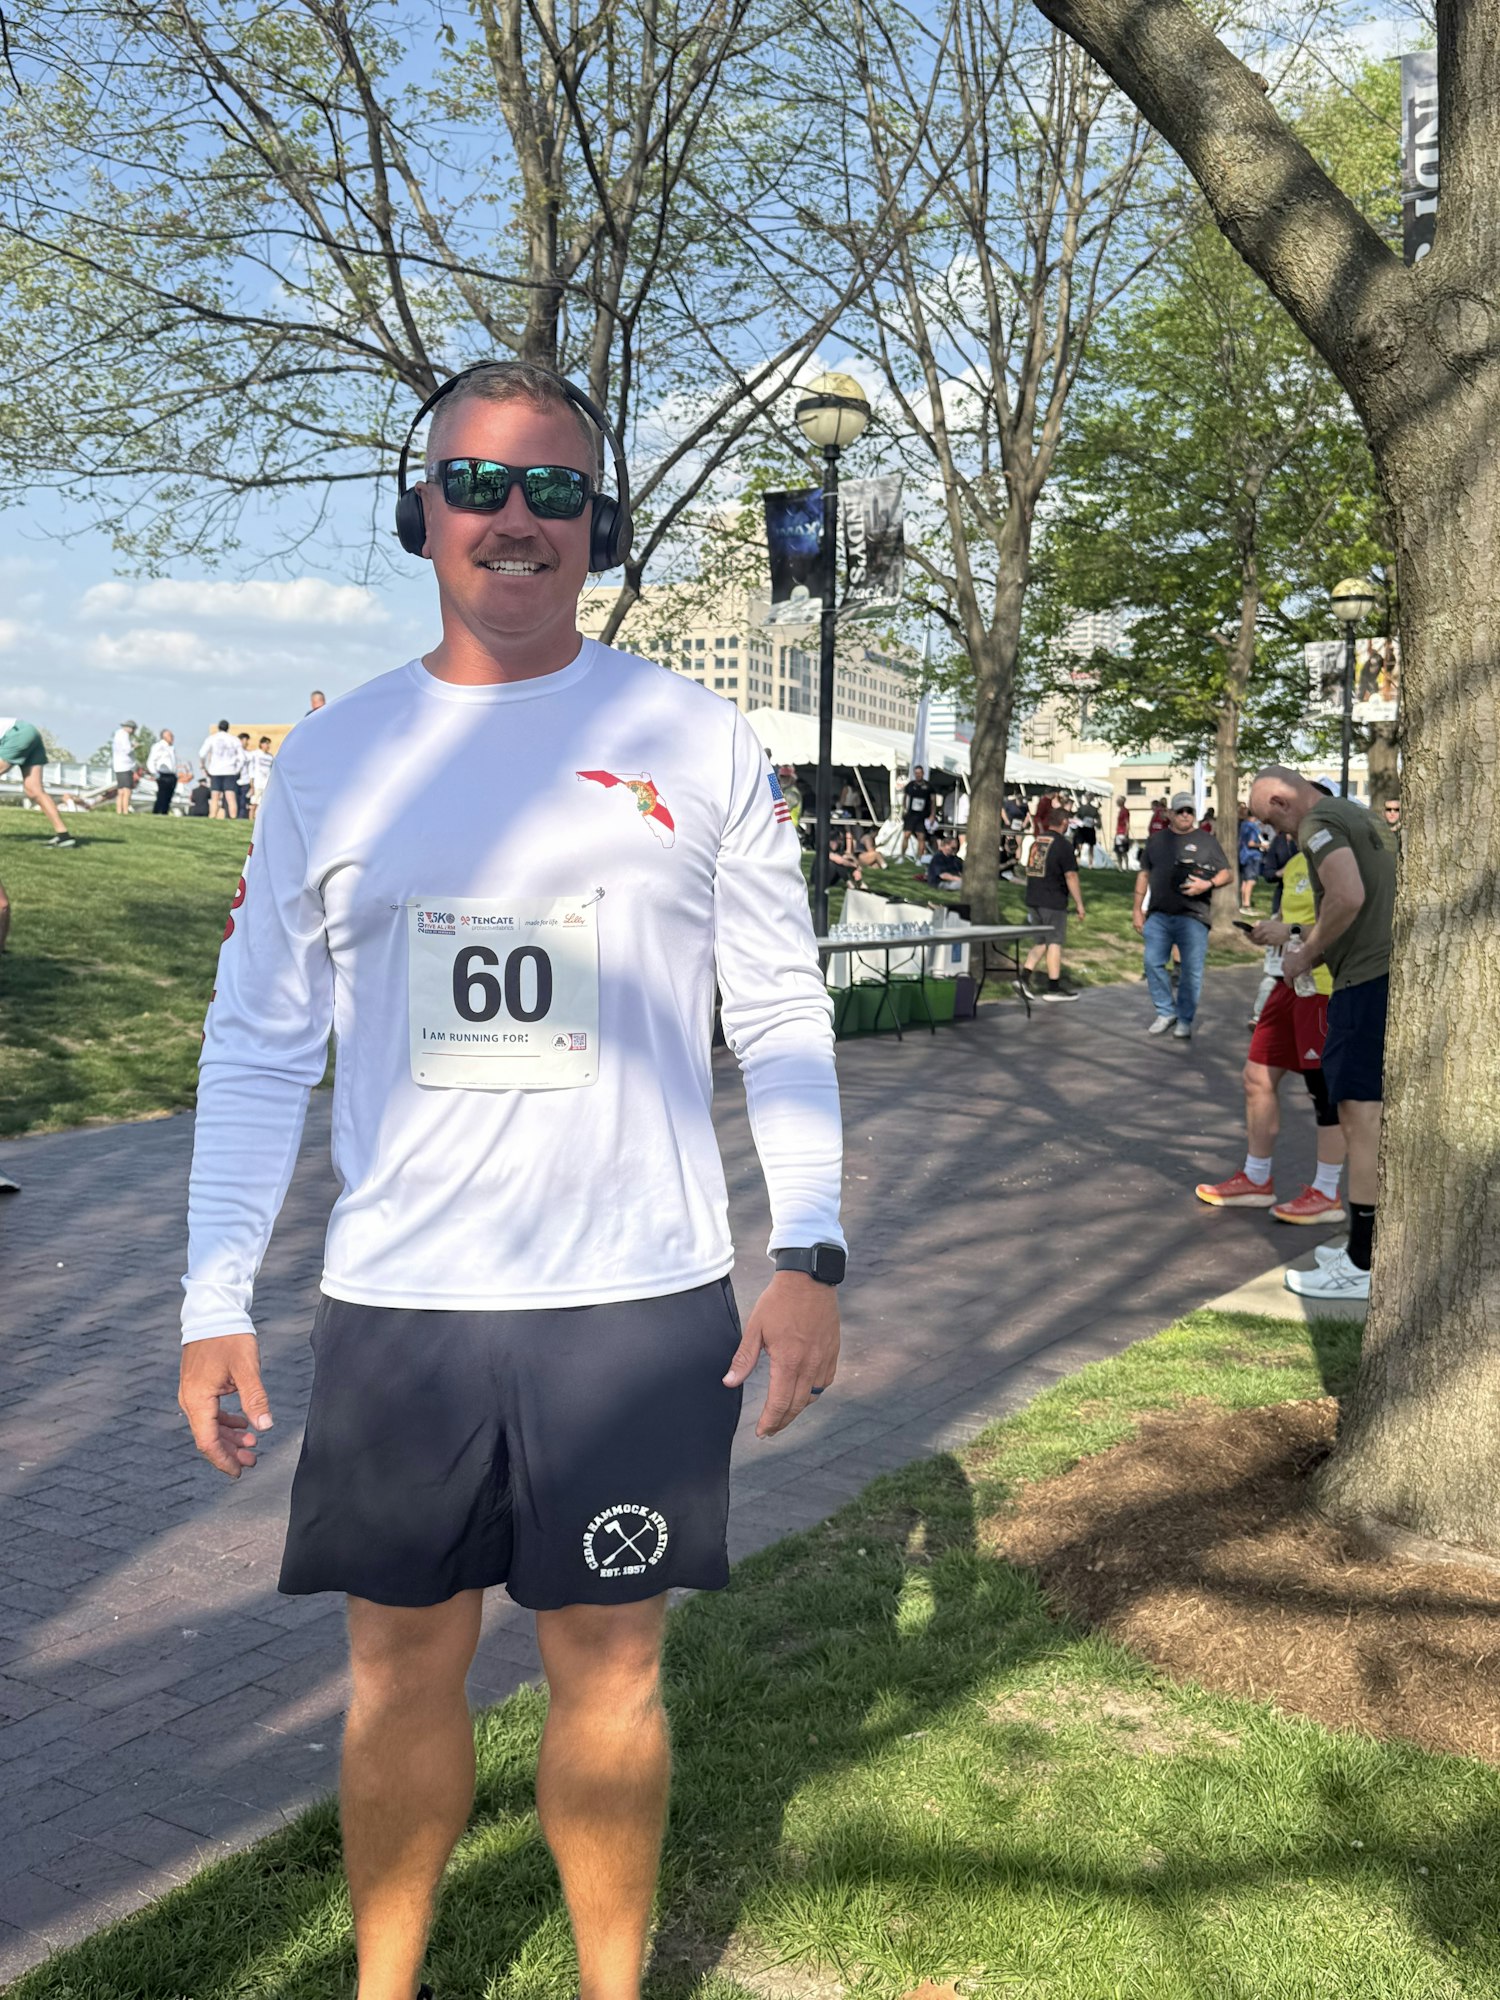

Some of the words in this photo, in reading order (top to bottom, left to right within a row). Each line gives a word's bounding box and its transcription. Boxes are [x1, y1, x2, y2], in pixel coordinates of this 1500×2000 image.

[844, 496, 868, 584] INDY'S
[846, 584, 884, 599] back
[417, 911, 425, 933] 2026
[432, 912, 447, 924] 5K
[540, 919, 549, 927] for
[563, 913, 586, 924] Lilly
[452, 945, 553, 1023] 60
[422, 1027, 427, 1040] I
[430, 1033, 446, 1041] AM
[450, 1033, 499, 1043] RUNNING
[503, 1033, 529, 1043] FOR:
[587, 1504, 650, 1533] HAMMOCK
[647, 1511, 668, 1566] ATHLETICS
[582, 1532, 599, 1571] CEDAR
[600, 1567, 621, 1578] EST.
[622, 1564, 647, 1575] 1957
